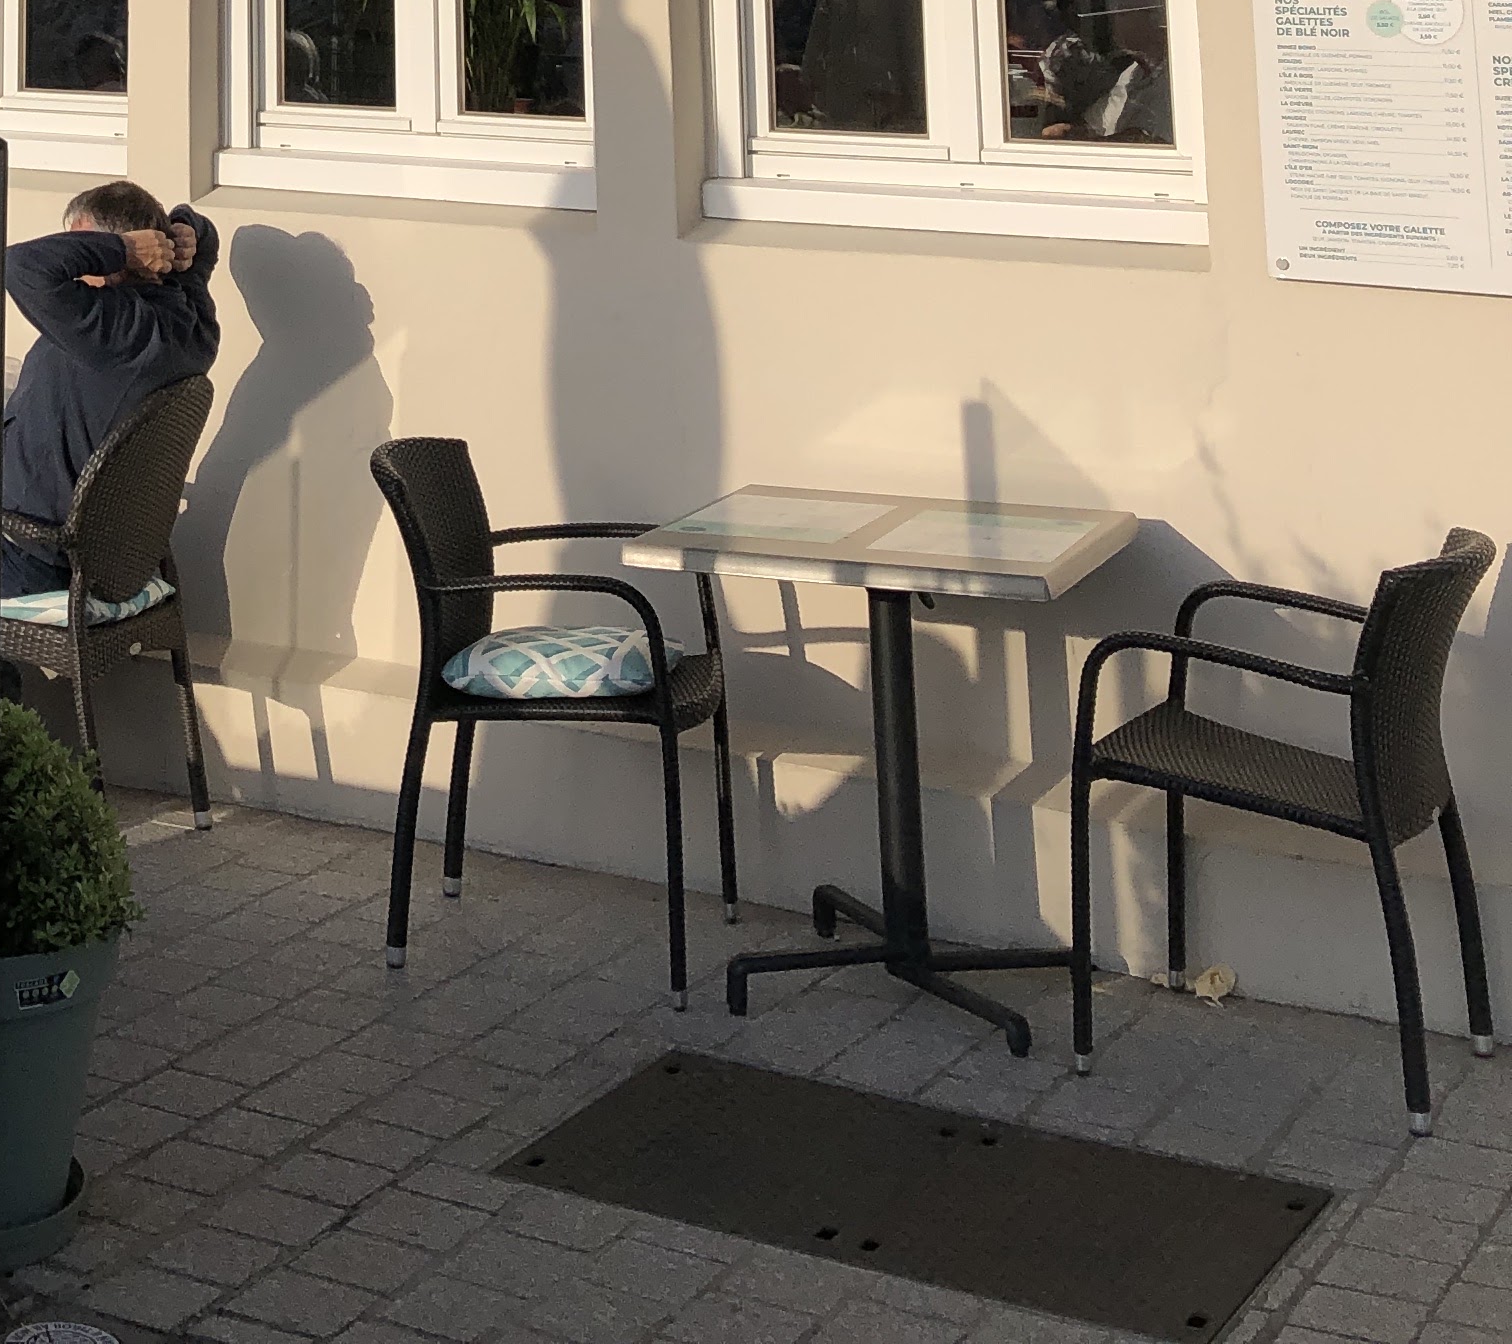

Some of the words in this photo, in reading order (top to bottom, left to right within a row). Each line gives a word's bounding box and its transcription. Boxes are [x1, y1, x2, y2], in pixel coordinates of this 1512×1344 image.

[1275, 5, 1348, 16] SPÉCIALITÉS
[1276, 17, 1334, 27] GALETTES
[1277, 28, 1293, 37] DE
[1296, 26, 1317, 37] BLÉ
[1321, 28, 1350, 38] NOIR
[1494, 77, 1512, 87] CR
[1315, 220, 1368, 231] COMPOSEZ
[1369, 223, 1401, 233] VOTRE
[1403, 225, 1446, 236] GALETTE
